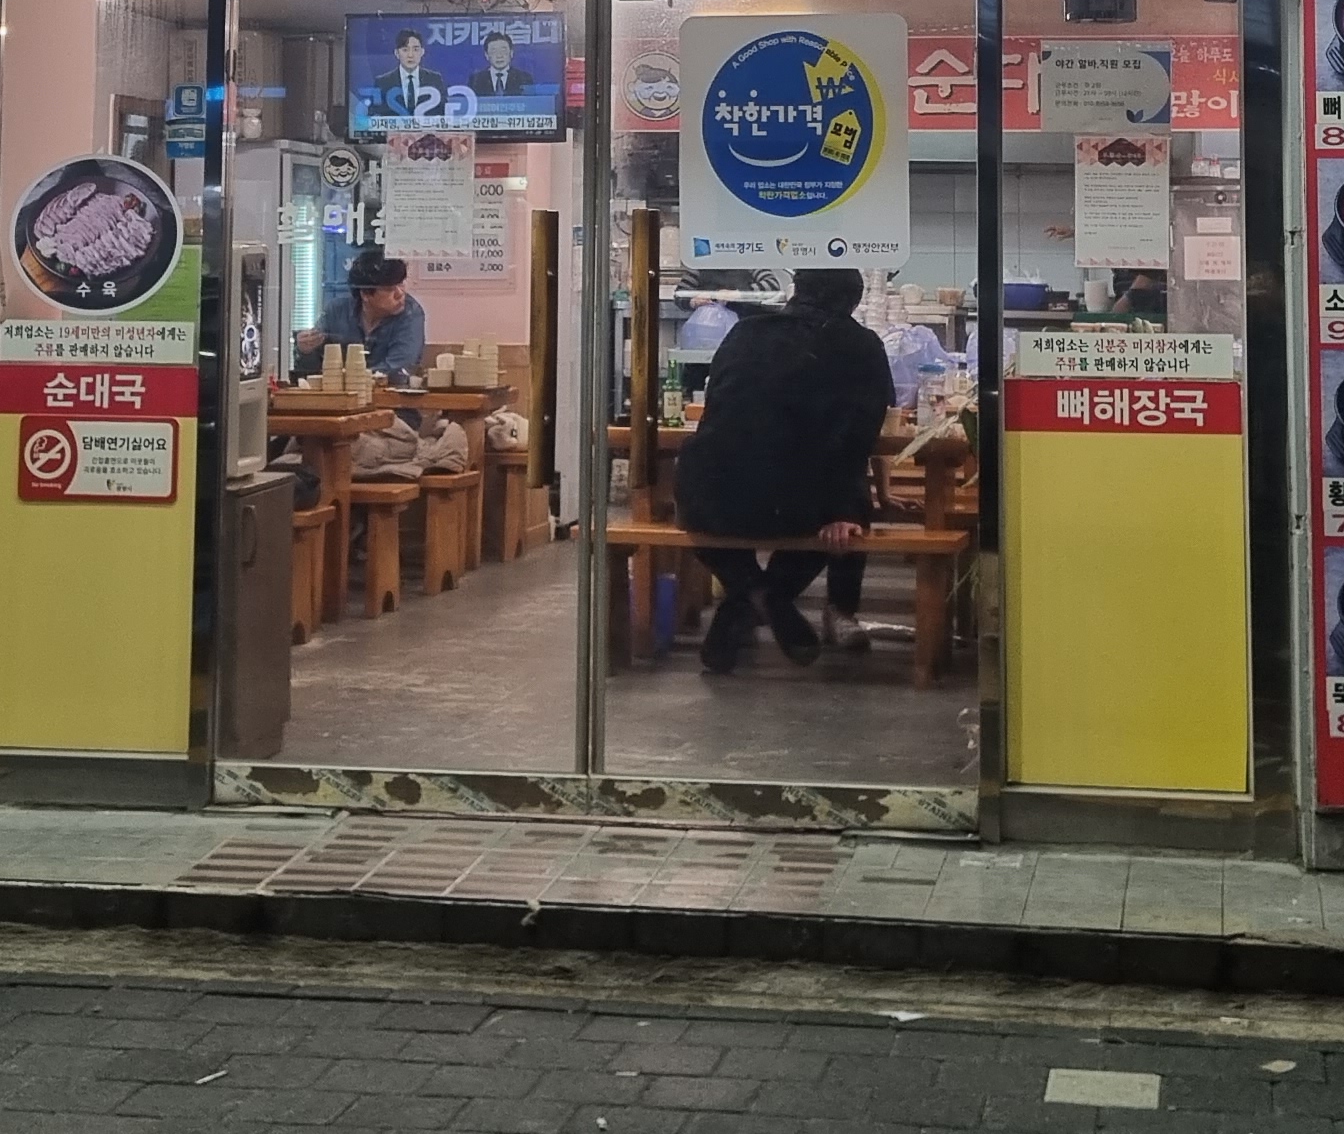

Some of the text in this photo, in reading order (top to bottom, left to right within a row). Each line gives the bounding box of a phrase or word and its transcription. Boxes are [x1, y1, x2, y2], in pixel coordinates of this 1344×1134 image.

[715, 101, 858, 150] 착한가격 모범
[4, 326, 187, 342] 저희업소는 19세미만의 미성년자에게는
[35, 343, 154, 358] 주류를 판매하지 않습니다
[1033, 338, 1213, 355] 저희업소는 신분증 미지참자에게는
[1056, 357, 1190, 373] 주류를 판매하지 않습니다
[43, 372, 146, 409] 순대국
[1056, 388, 1208, 427] 뼈해장국
[82, 436, 167, 452] 담배연기싫어요
